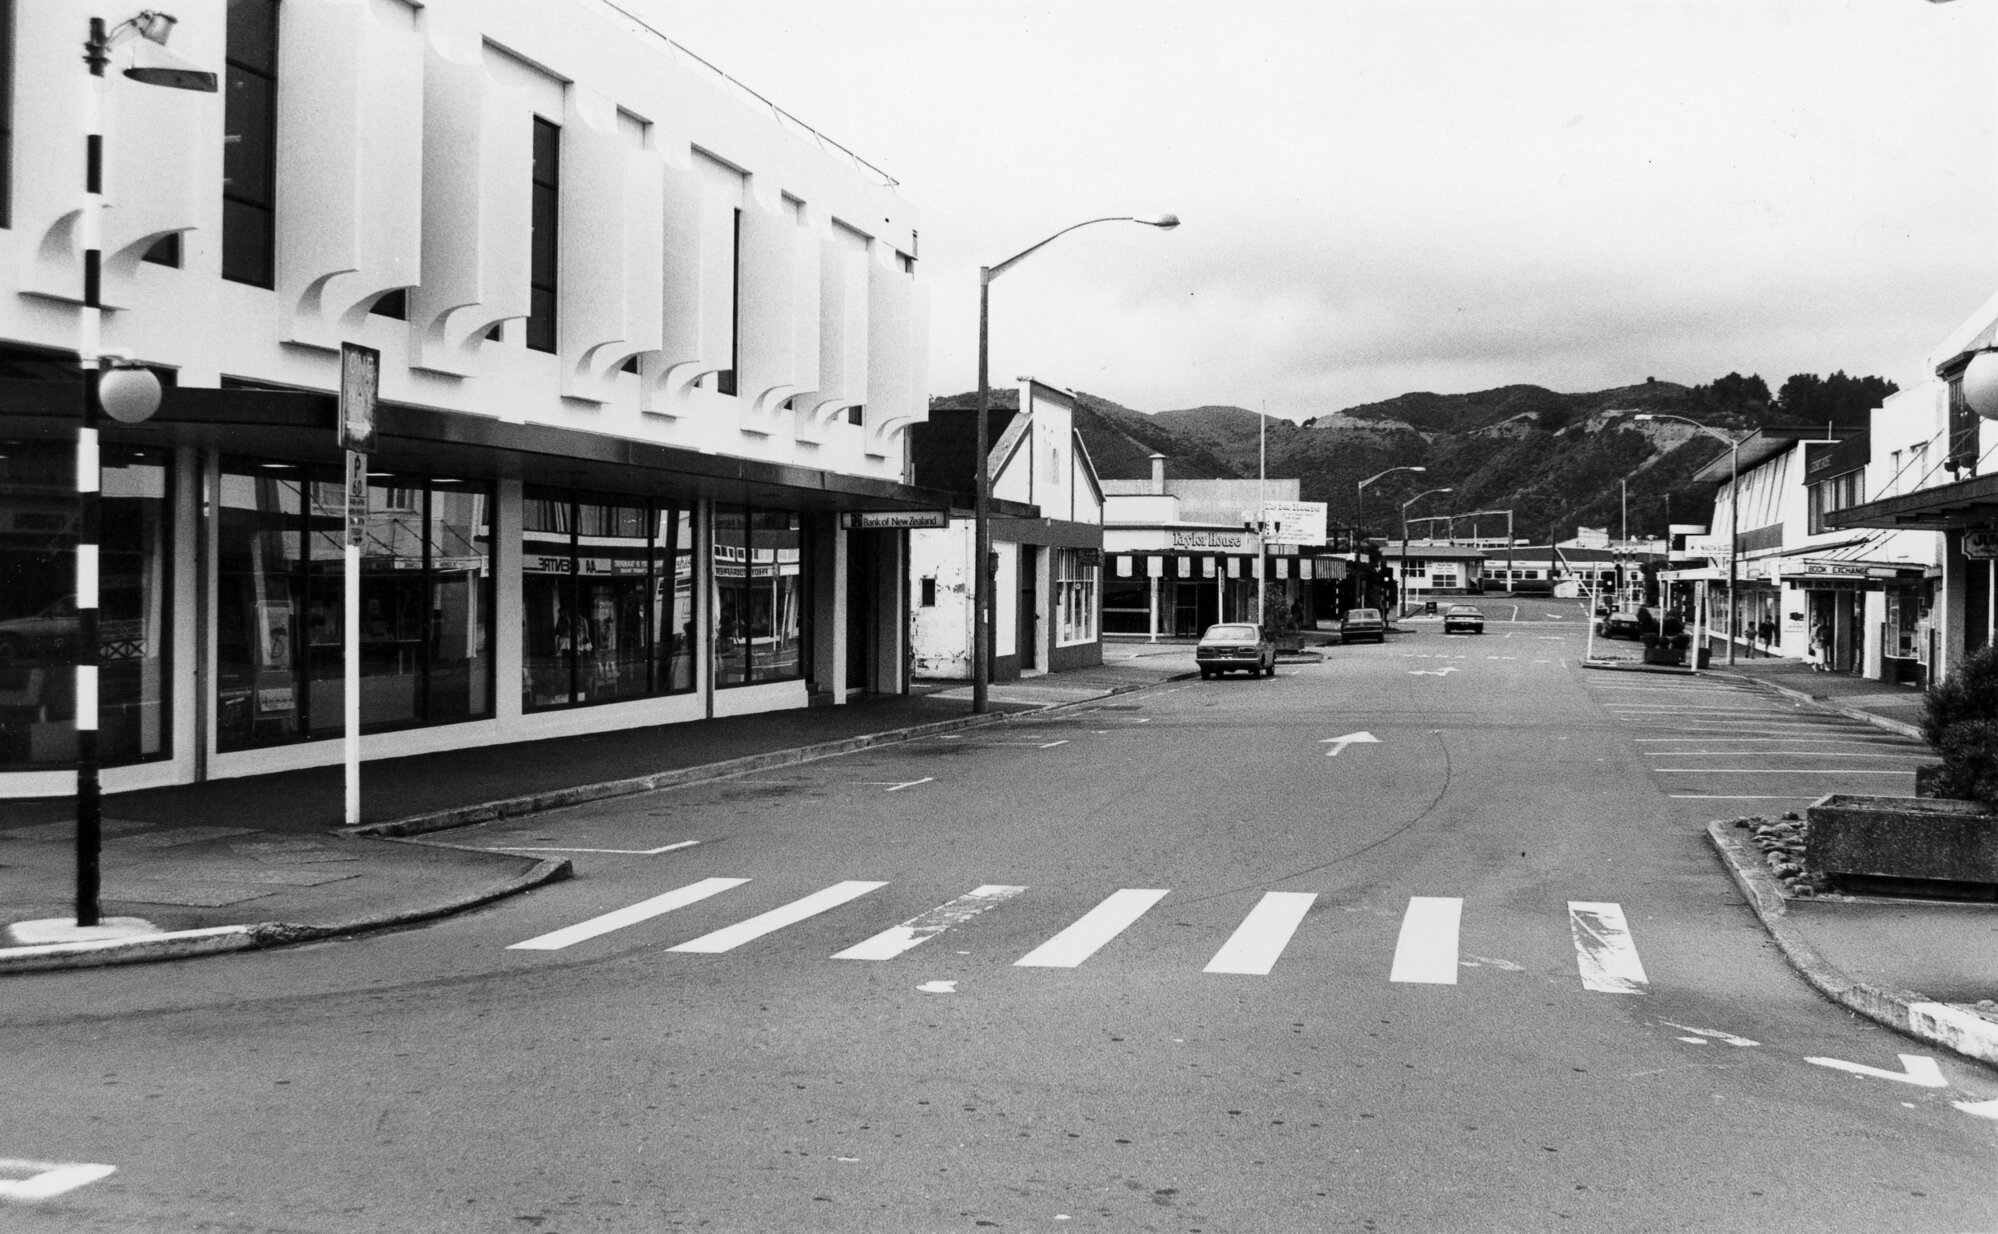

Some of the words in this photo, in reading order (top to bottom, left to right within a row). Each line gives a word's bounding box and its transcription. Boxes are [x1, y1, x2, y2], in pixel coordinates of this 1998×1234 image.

[349, 351, 374, 378] ONE
[863, 517, 881, 526] Bank
[881, 518, 890, 526] of
[891, 517, 909, 526] New
[909, 516, 937, 525] Zealand
[1173, 532, 1206, 549] Taylor
[1208, 532, 1241, 547] House
[1808, 565, 1827, 573] BOOK
[1832, 566, 1869, 575] EXCHANGE
